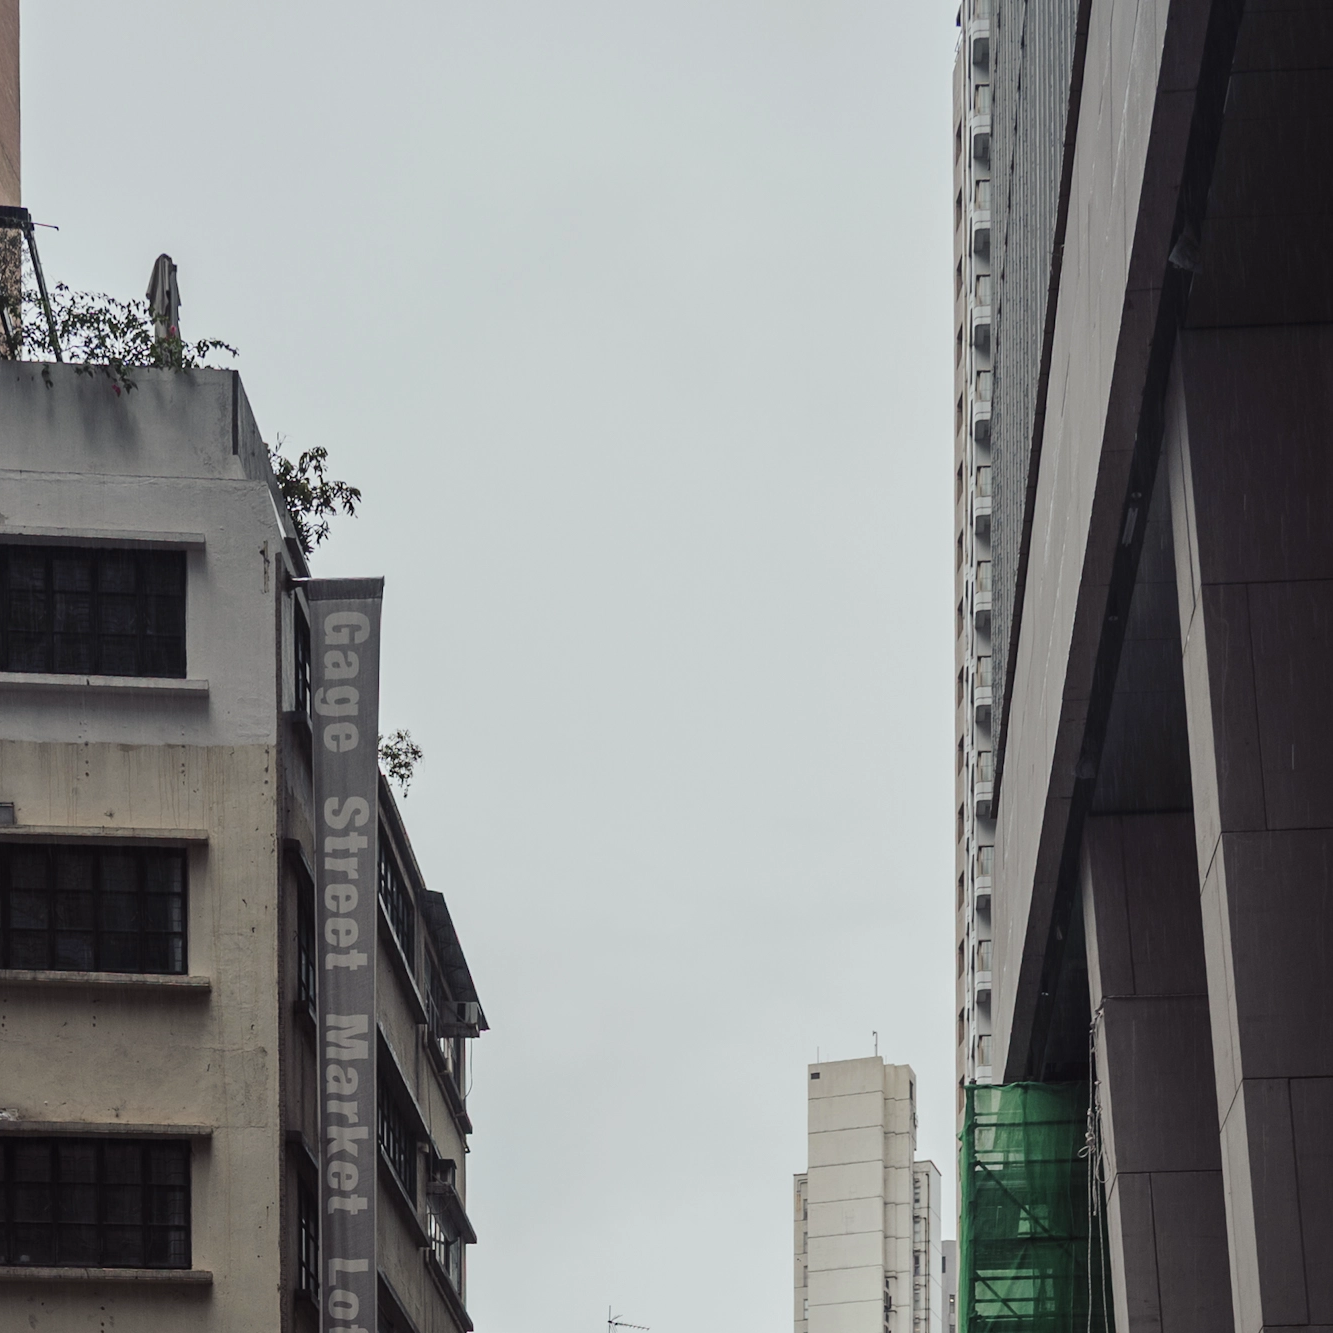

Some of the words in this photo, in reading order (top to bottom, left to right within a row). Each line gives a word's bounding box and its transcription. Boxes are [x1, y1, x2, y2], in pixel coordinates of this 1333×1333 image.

[315, 610, 370, 754] Gage
[323, 796, 370, 971] Street
[324, 1014, 369, 1215] Market
